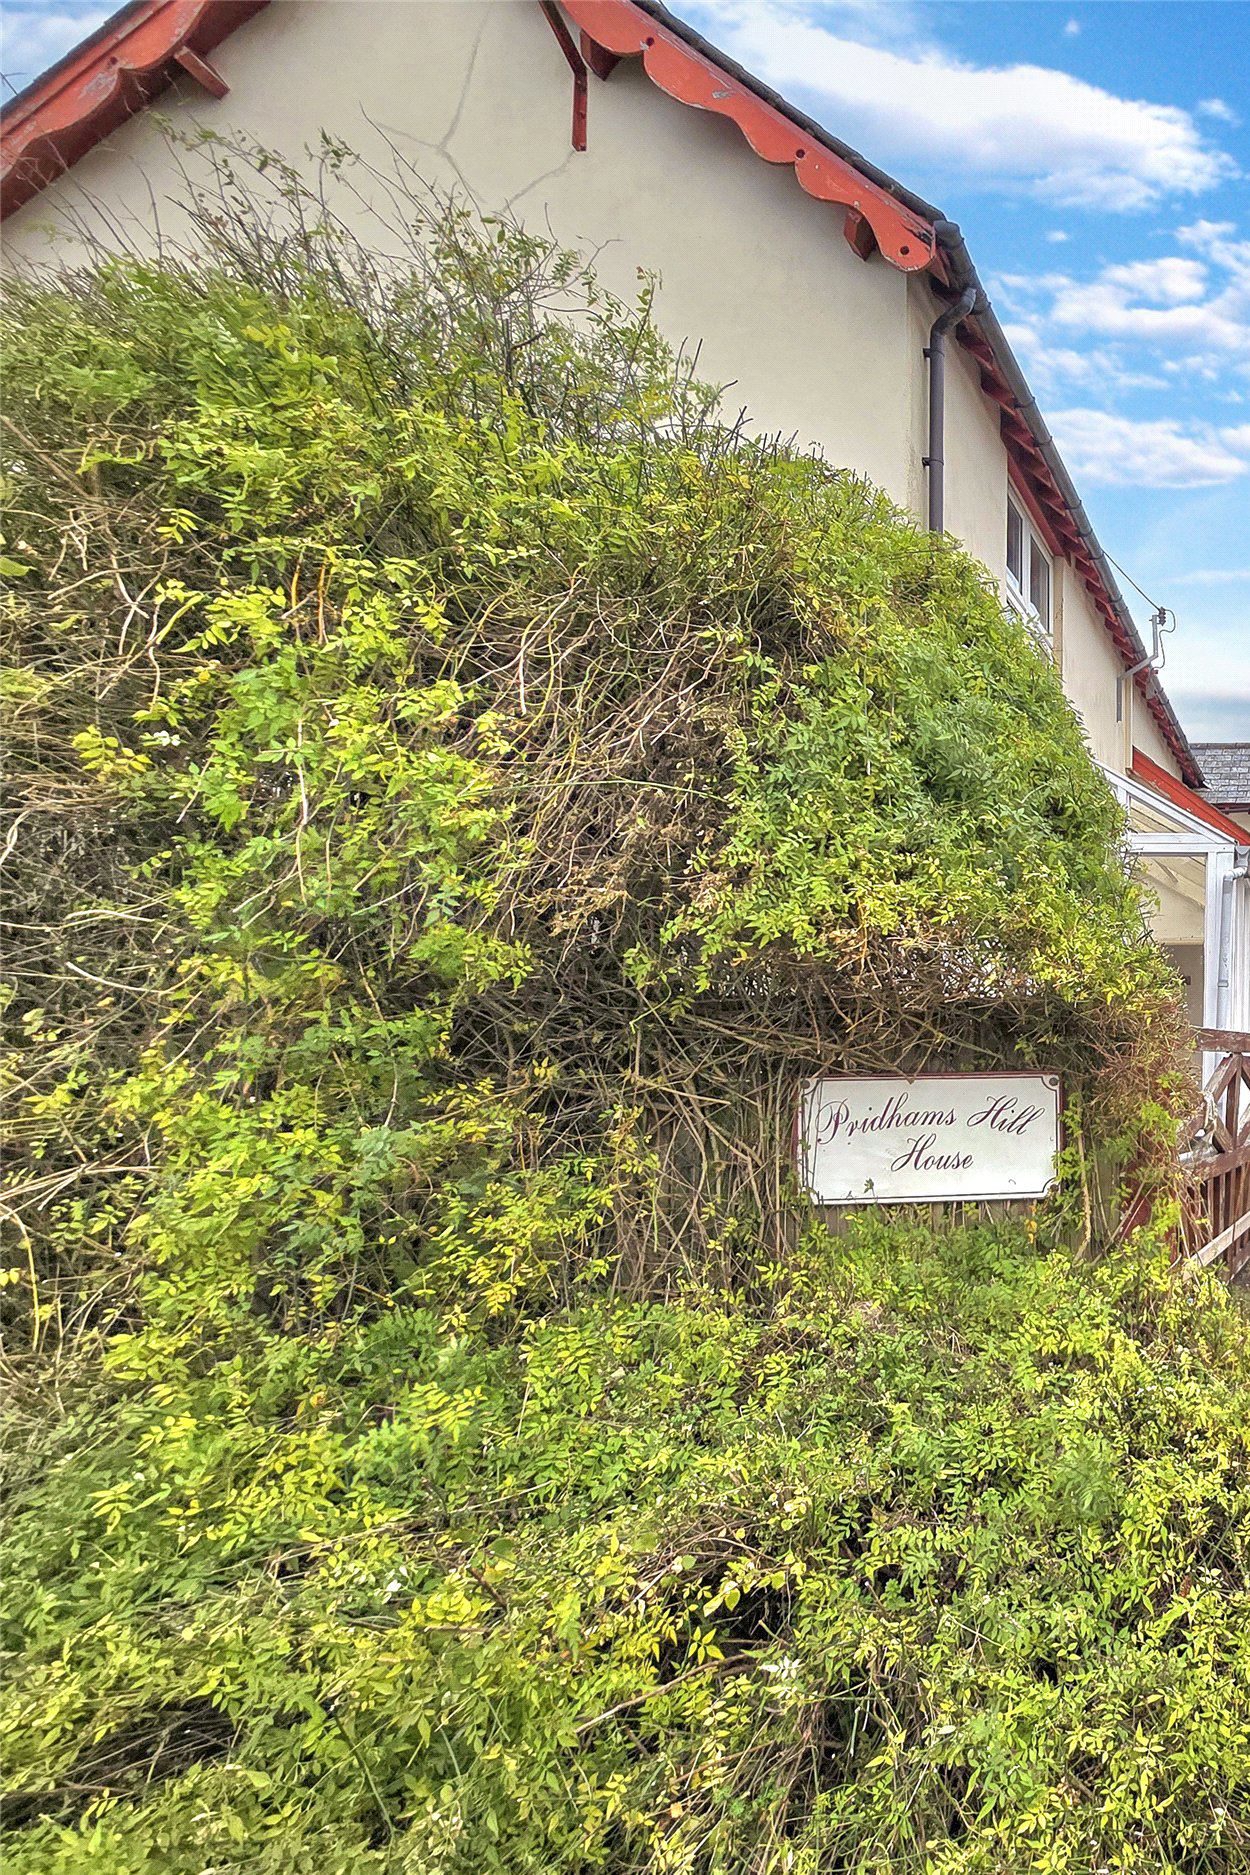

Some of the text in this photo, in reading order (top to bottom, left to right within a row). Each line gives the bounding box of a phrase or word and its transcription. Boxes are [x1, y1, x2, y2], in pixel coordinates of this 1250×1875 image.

[815, 1091, 1046, 1145] Pridhams Hill
[890, 1133, 974, 1172] House
